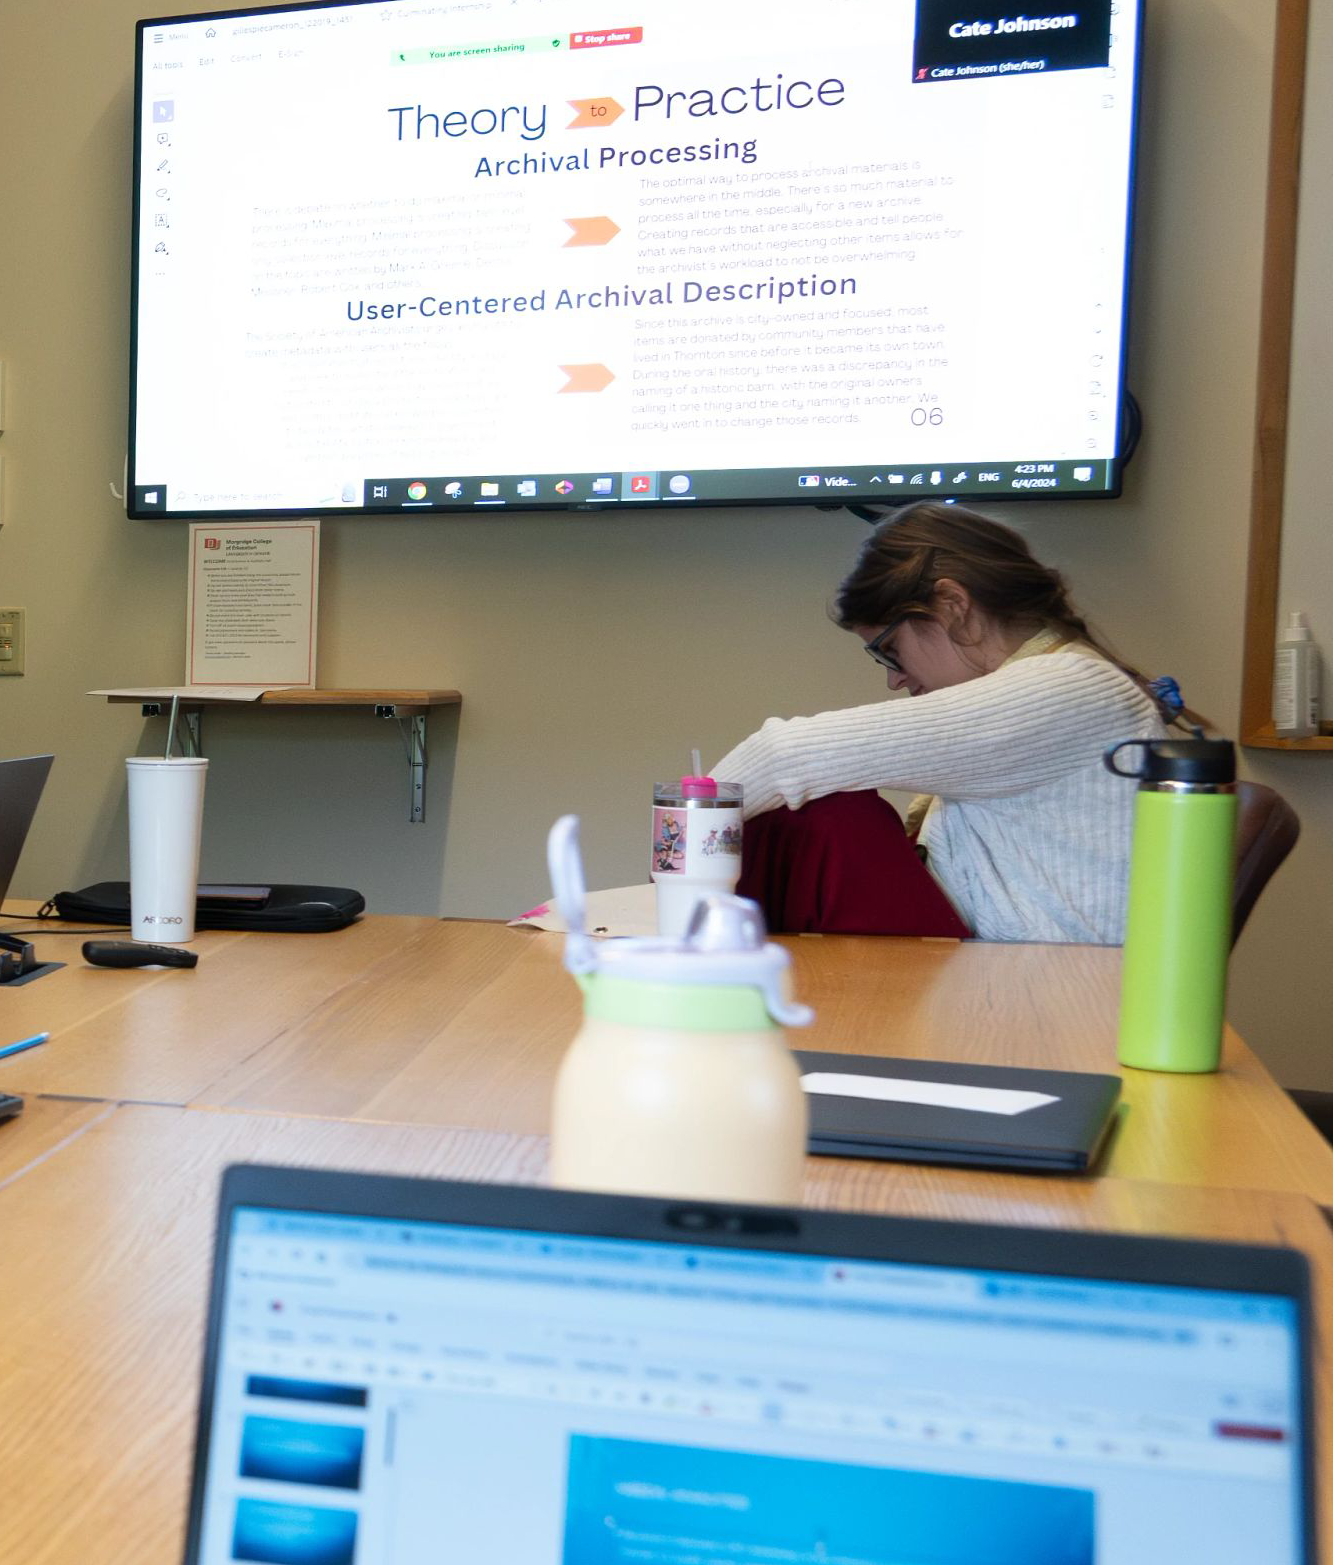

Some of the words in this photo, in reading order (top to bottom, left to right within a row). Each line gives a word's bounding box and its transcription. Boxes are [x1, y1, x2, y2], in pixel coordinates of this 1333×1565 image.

[949, 21, 991, 38] Cate
[994, 14, 1076, 35] Johnson
[585, 34, 605, 45] Stop
[607, 31, 630, 43] share
[463, 47, 491, 56] screen
[492, 43, 525, 53] sharing
[931, 67, 954, 78] Cate
[955, 63, 997, 76] Johnson
[998, 58, 1045, 73] (she/her)
[386, 103, 547, 141] Theory
[590, 103, 608, 118] to
[633, 72, 845, 122] Practice
[473, 147, 590, 178] Archival
[599, 136, 758, 169] Processing
[639, 178, 659, 189] The
[662, 175, 706, 188] optimal
[708, 175, 732, 185] way
[735, 173, 748, 182] to
[750, 169, 799, 183] process
[801, 164, 848, 177] archival
[851, 161, 908, 173] materials
[911, 160, 920, 169] is
[638, 193, 705, 207] somewhere
[720, 190, 740, 200] the
[832, 183, 848, 193] so
[850, 181, 883, 191] much
[885, 176, 937, 188] material
[940, 176, 954, 185] to
[638, 212, 683, 226] process
[686, 209, 700, 220] all
[701, 210, 721, 219] the
[755, 202, 813, 216] especially
[837, 201, 845, 210] a
[848, 200, 872, 209] new
[637, 229, 688, 241] Creating
[690, 224, 736, 236] records
[739, 223, 764, 234] that
[766, 223, 788, 232] are
[790, 218, 852, 230] accessible
[854, 215, 878, 226] and
[881, 214, 899, 225] tell
[637, 247, 666, 257] what
[668, 246, 685, 255] we
[688, 244, 716, 254] have
[718, 241, 763, 252] without
[766, 238, 827, 251] neglecting
[829, 235, 863, 245] other
[636, 265, 655, 275] the
[719, 257, 773, 270] workload
[775, 257, 788, 267] to
[790, 255, 811, 265] not
[813, 255, 829, 264] be
[346, 288, 545, 328] User-Centered
[554, 281, 673, 310] Archival
[682, 273, 857, 305] Description
[633, 318, 665, 329] Since
[667, 318, 688, 328] this
[690, 316, 733, 326] archive
[735, 315, 745, 324] is
[816, 309, 839, 320] and
[897, 305, 929, 316] most
[633, 337, 664, 346] items
[667, 335, 687, 345] are
[689, 331, 738, 343] donated
[741, 332, 756, 343] by
[758, 329, 824, 340] community
[826, 326, 883, 336] members
[886, 324, 913, 334] that
[915, 323, 945, 333] have
[632, 352, 659, 362] lived
[728, 349, 757, 358] since
[759, 345, 801, 357] before
[803, 345, 812, 355] it
[814, 344, 863, 354] became
[865, 343, 881, 352] its
[883, 342, 910, 351] own
[632, 369, 669, 380] During
[672, 369, 691, 378] the
[693, 367, 716, 377] oral
[765, 364, 798, 373] there
[800, 363, 825, 372] was
[827, 363, 835, 372] a
[837, 360, 912, 371] discrepancy
[928, 358, 948, 367] the
[632, 387, 673, 397] naming
[675, 383, 687, 395] of
[690, 386, 698, 394] a
[780, 380, 806, 390] with
[808, 380, 828, 389] the
[830, 379, 874, 391] original
[877, 377, 922, 387] owners
[631, 404, 666, 414] calling
[668, 403, 676, 412] it
[679, 403, 700, 411] one
[703, 401, 732, 412] thing
[734, 399, 757, 410] and
[759, 399, 778, 408] the
[781, 398, 804, 410] city
[806, 397, 850, 408] naming
[852, 396, 860, 405] it
[917, 392, 938, 403] We
[630, 421, 668, 432] quickly
[671, 419, 700, 429] went
[714, 418, 727, 427] to
[729, 417, 773, 428] change
[775, 416, 809, 425] those
[910, 406, 943, 426] 06
[978, 472, 999, 482] ENG
[1014, 464, 1036, 473] 4:23
[1037, 463, 1054, 473] PM
[1011, 478, 1057, 488] 6/4/2024
